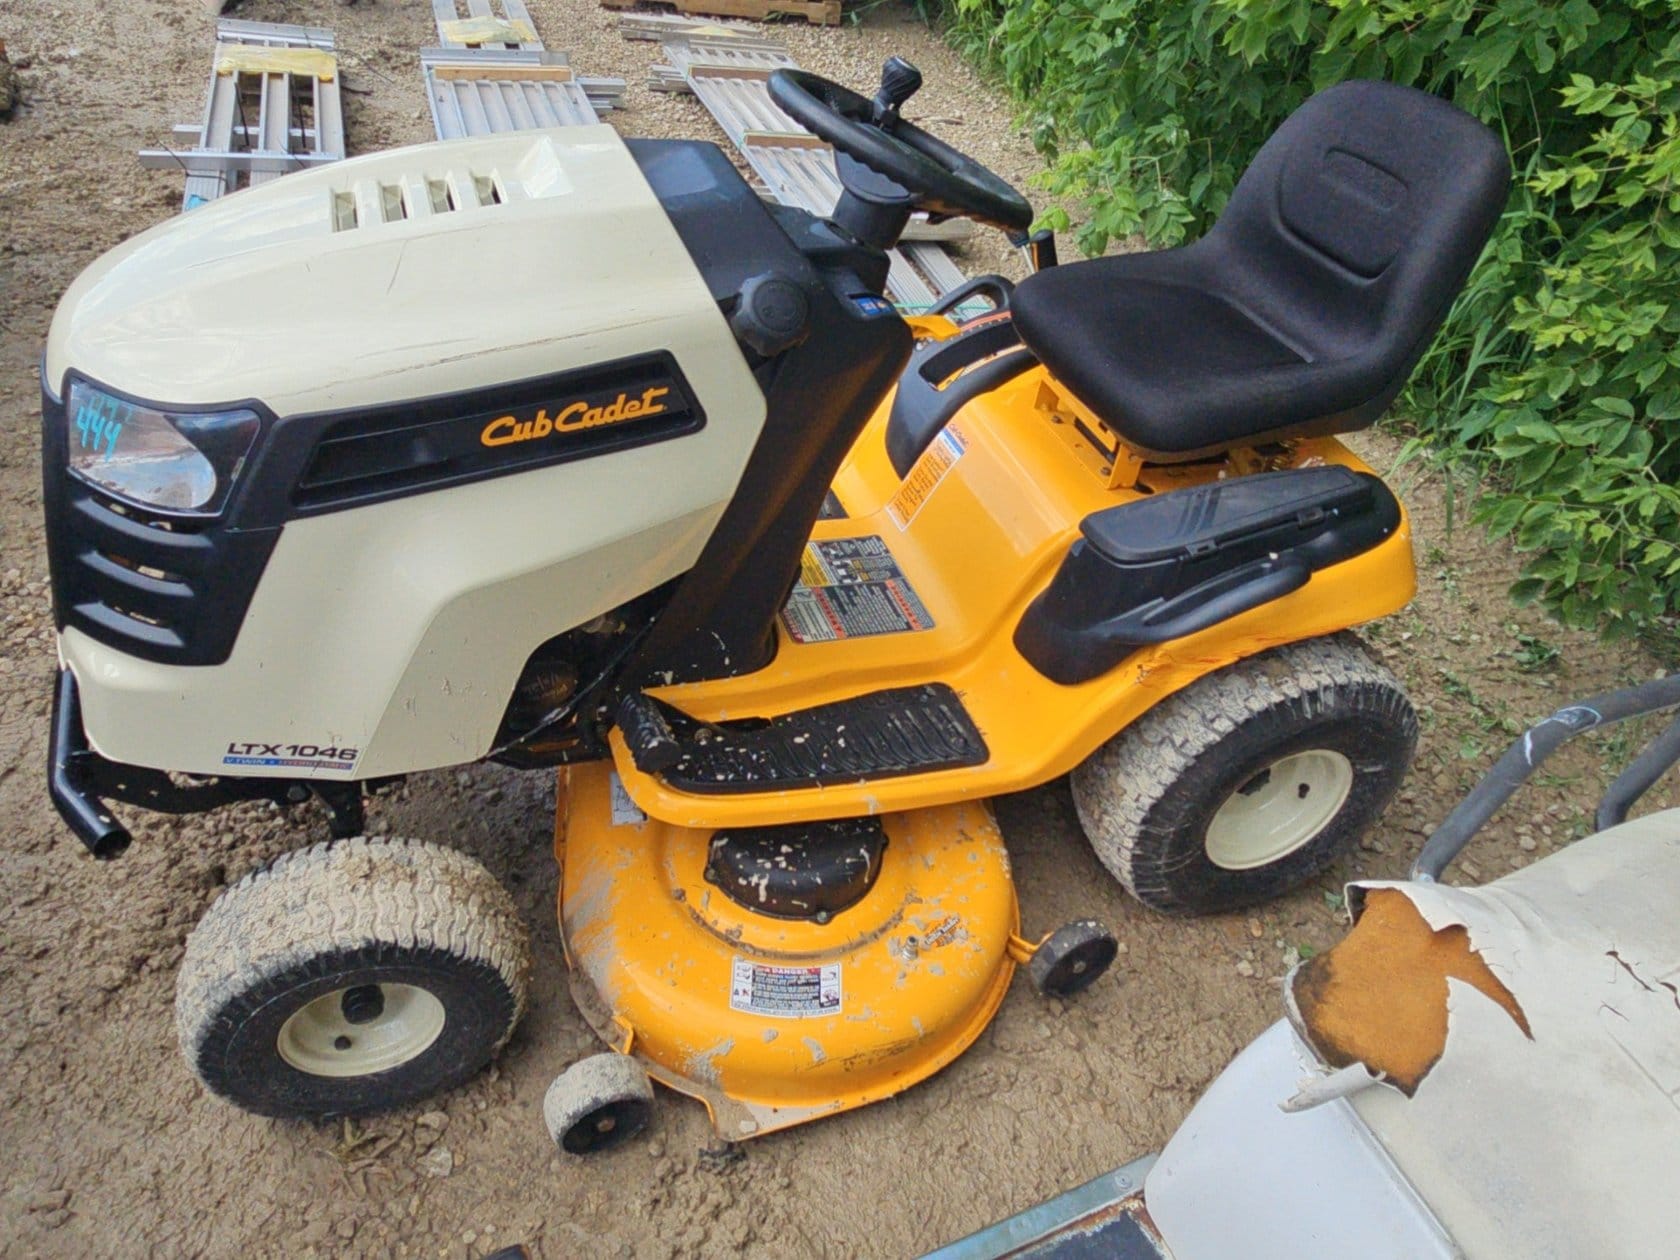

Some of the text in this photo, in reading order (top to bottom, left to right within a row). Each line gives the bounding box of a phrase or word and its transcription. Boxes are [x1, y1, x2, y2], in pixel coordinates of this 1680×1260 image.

[480, 387, 669, 446] Cub Cadet
[227, 742, 359, 761] LTX 1046
